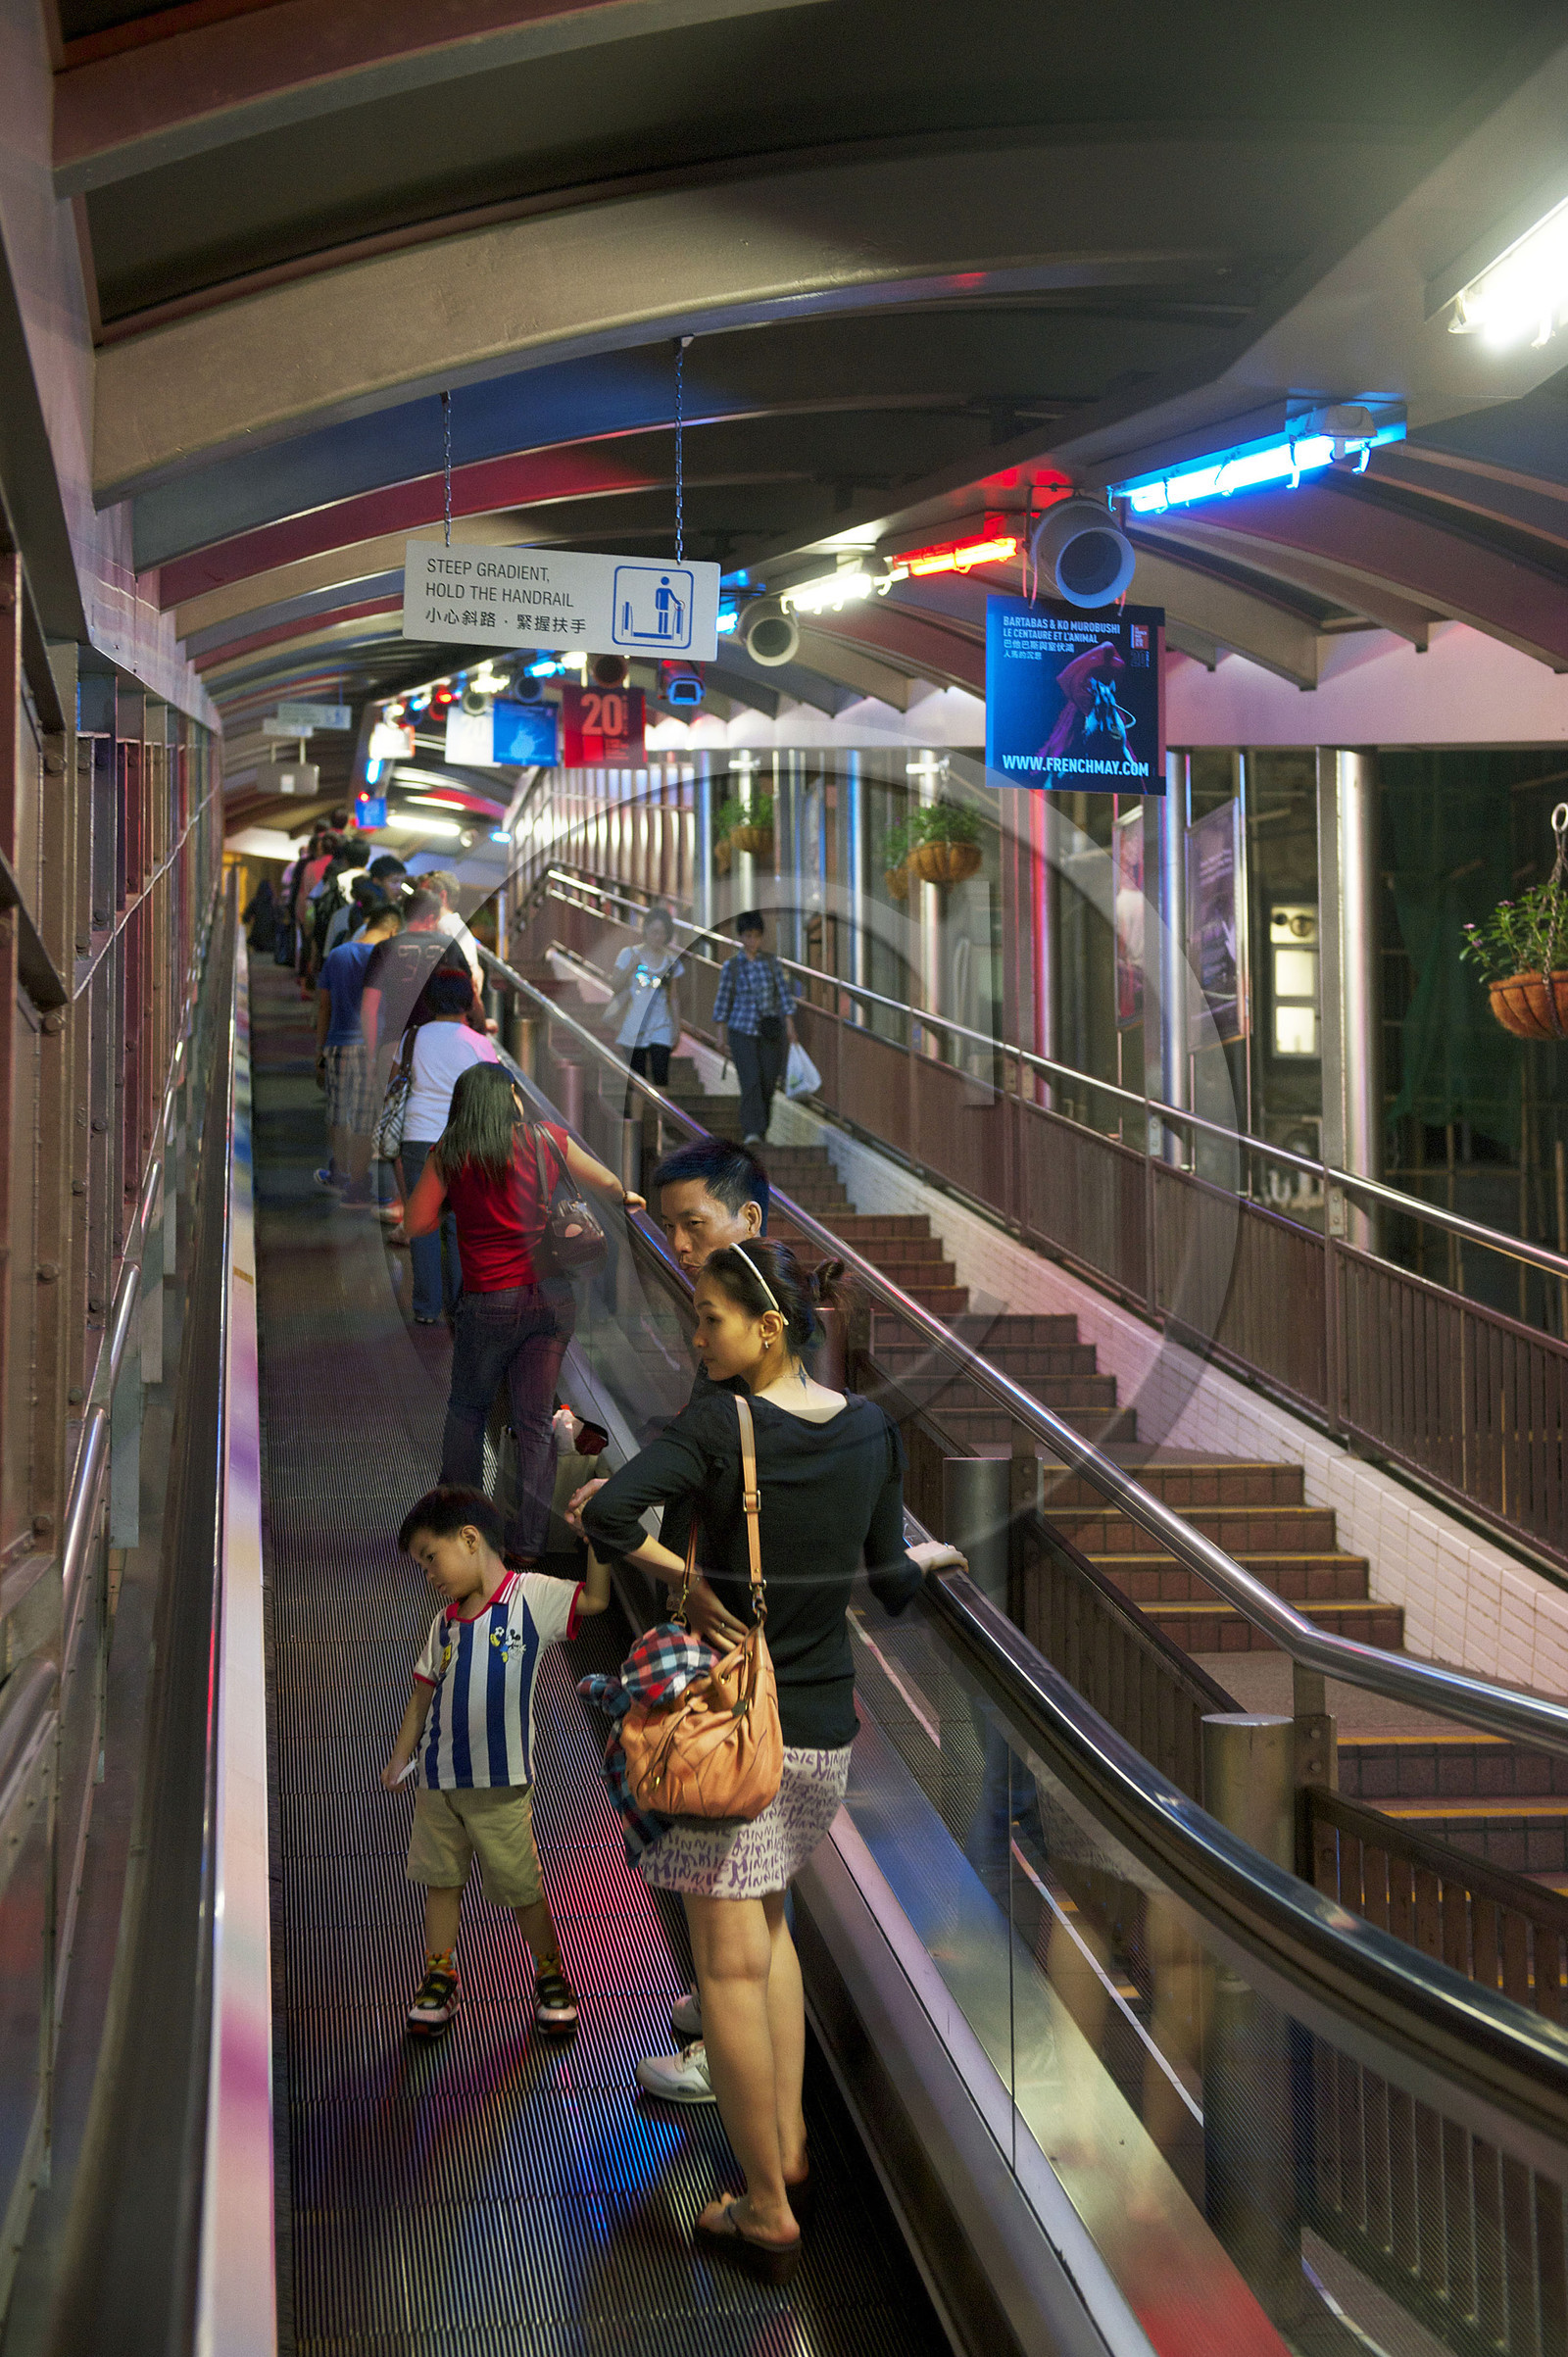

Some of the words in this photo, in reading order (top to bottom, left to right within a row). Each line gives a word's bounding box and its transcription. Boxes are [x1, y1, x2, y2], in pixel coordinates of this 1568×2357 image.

[427, 559, 472, 575] STEEP
[476, 563, 550, 583] GRADIENT,
[425, 582, 466, 600] HOLD
[469, 585, 497, 601] THE
[502, 588, 574, 608] HANDRAIL
[1003, 627, 1012, 638] LE
[1013, 628, 1053, 641] CENTAURE
[1054, 631, 1062, 641] ET
[1063, 632, 1099, 644] L'ANIMAL
[1004, 615, 1049, 629] BARTABAS
[1050, 619, 1055, 630] &
[1056, 619, 1069, 630] KO
[1070, 621, 1121, 635] MUROBUSHI
[581, 693, 622, 736] 20
[1002, 754, 1150, 777] WWW.FRENCHMAY.COM
